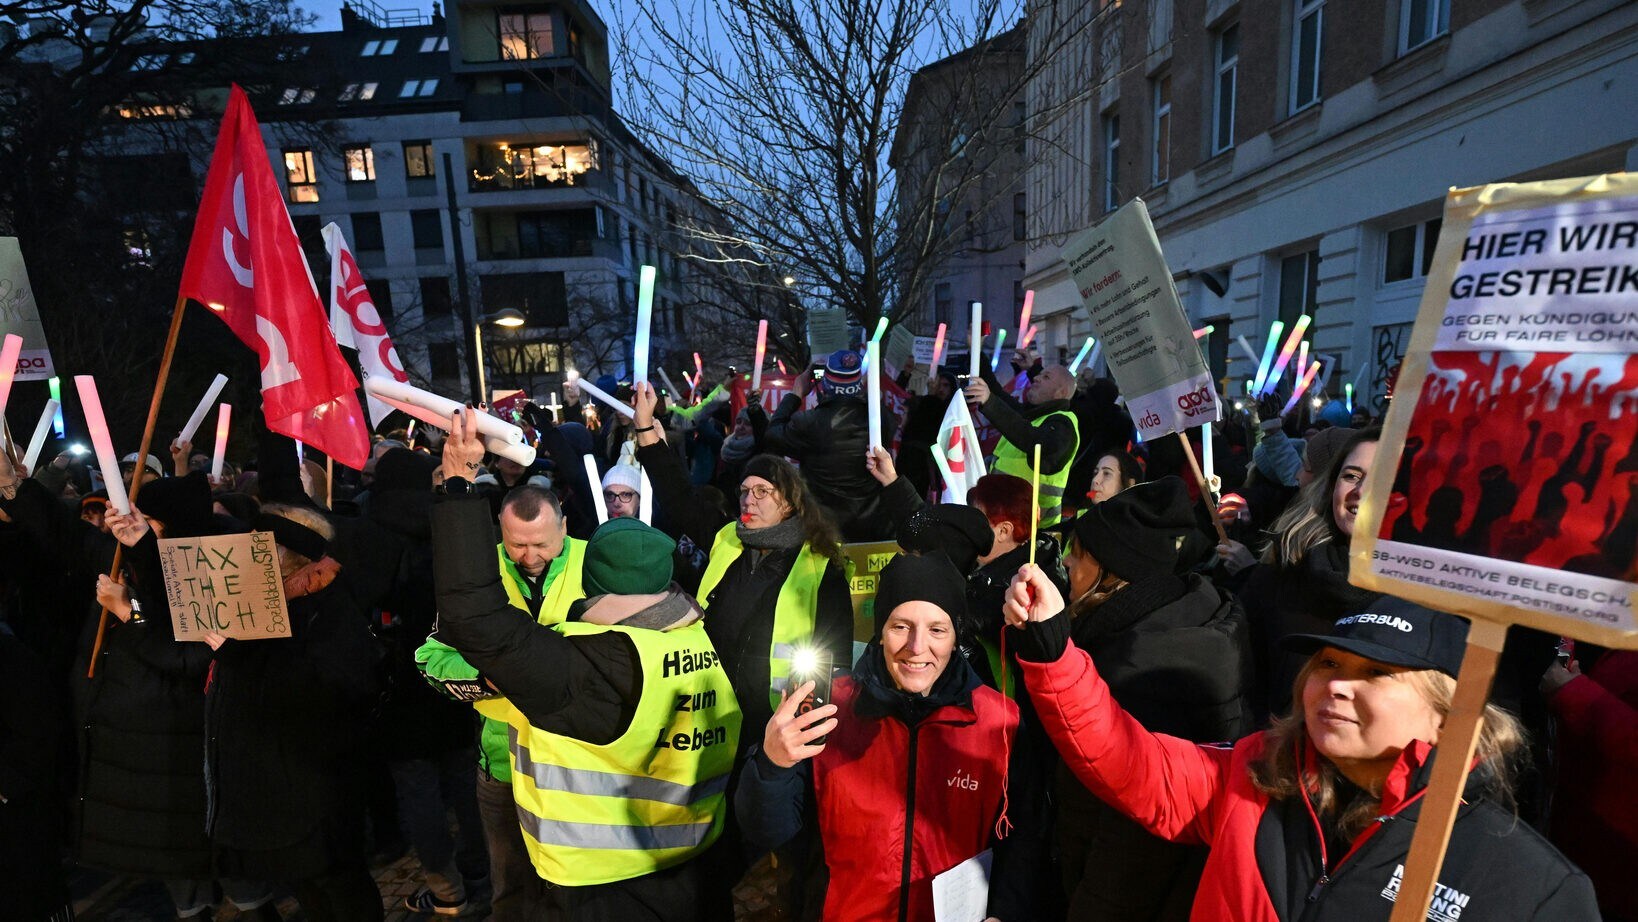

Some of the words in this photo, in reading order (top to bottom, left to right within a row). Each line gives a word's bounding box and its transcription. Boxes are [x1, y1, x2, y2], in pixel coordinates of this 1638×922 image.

[1460, 228, 1548, 262] HIER
[1080, 285, 1093, 300] Wir
[1092, 269, 1122, 293] fordern:
[1442, 313, 1510, 327] GEGEN
[1505, 330, 1569, 342] FAIRE
[1138, 409, 1161, 430] vida
[177, 546, 239, 572] TAX
[1439, 563, 1500, 582] AKTIVE
[183, 575, 242, 599] THE
[188, 601, 255, 631] RICH
[674, 689, 717, 712] zum
[654, 725, 726, 752] Leben
[947, 769, 979, 791] vida
